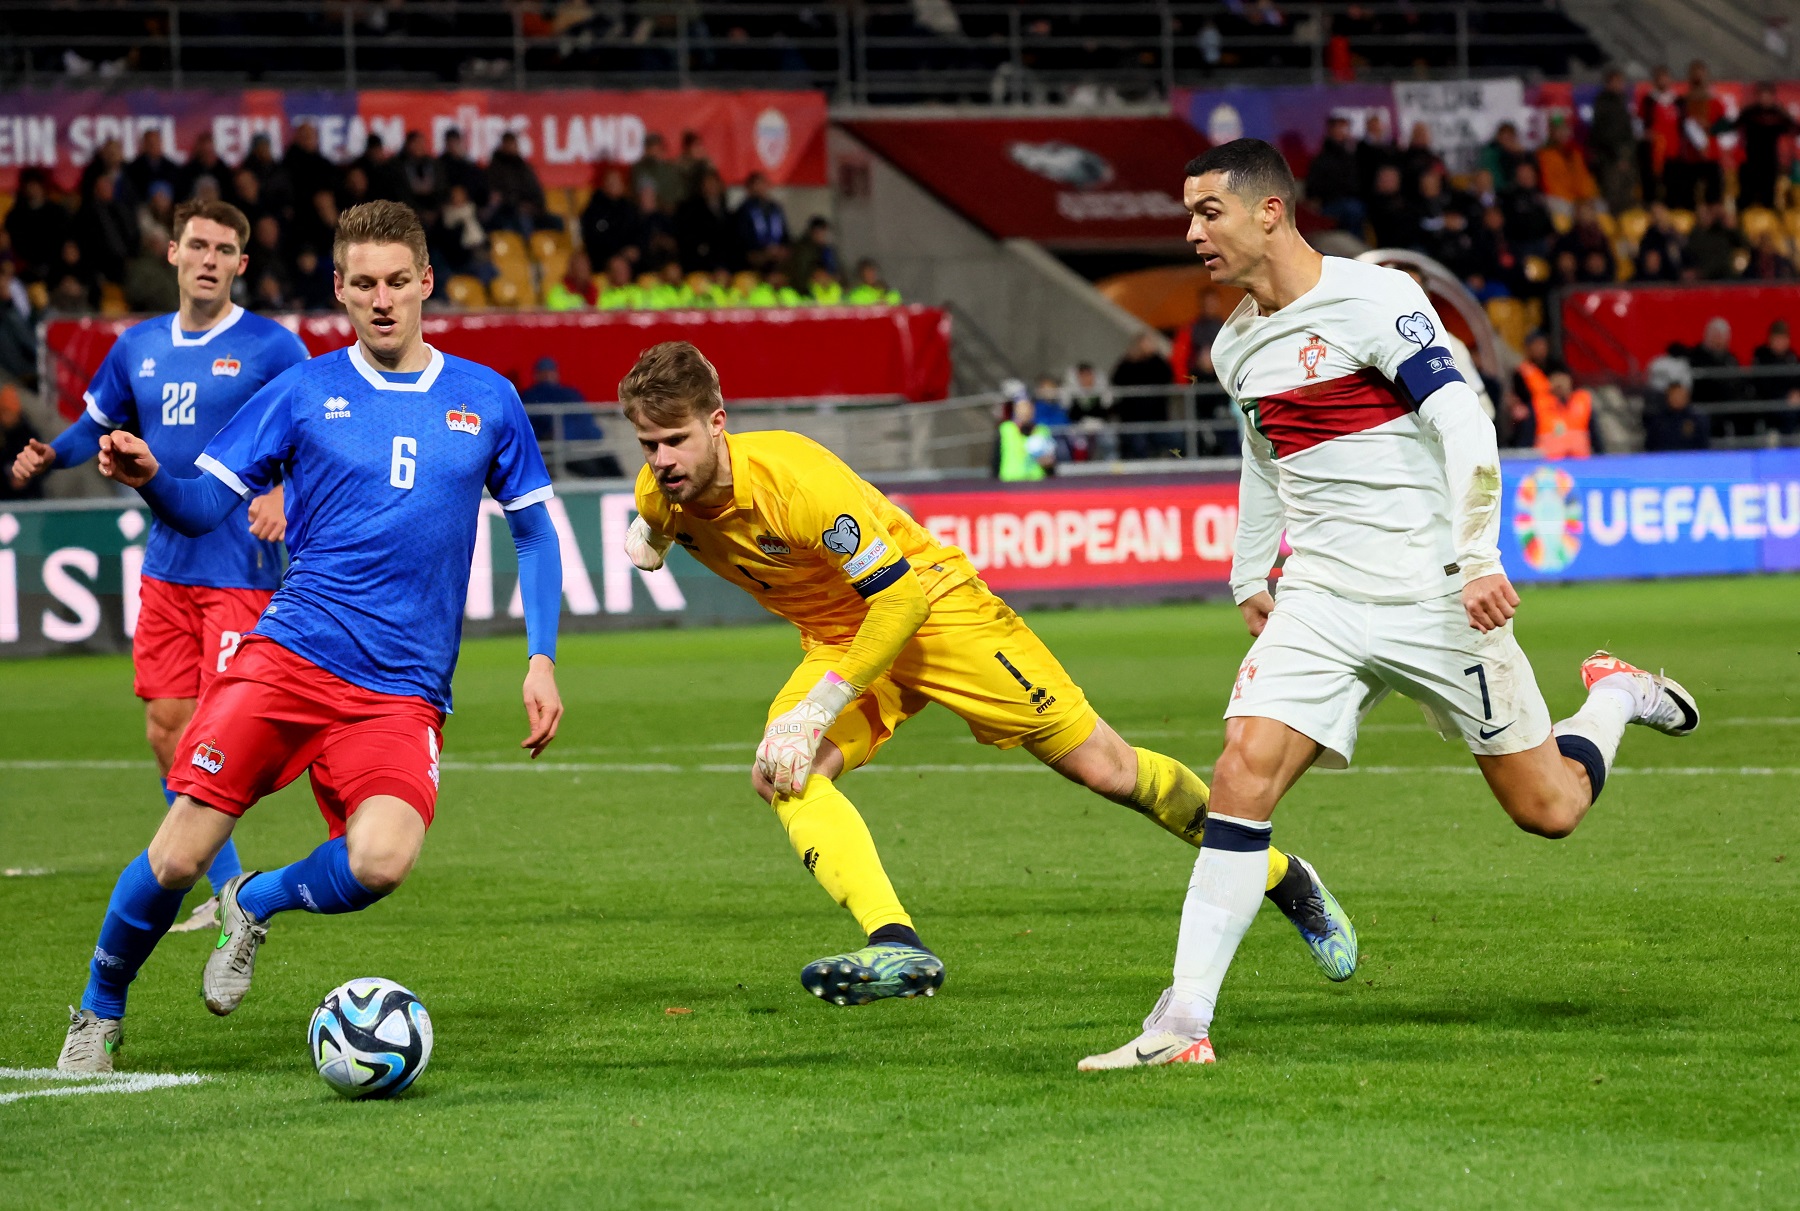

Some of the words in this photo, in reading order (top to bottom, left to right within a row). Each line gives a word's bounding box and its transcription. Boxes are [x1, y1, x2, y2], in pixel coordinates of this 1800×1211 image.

[542, 115, 645, 164] LAND
[162, 382, 197, 426] 22
[325, 410, 351, 420] errea
[389, 435, 417, 490] 6
[924, 506, 1182, 570] EUROPEAN
[217, 631, 247, 673] 2
[994, 651, 1033, 692] 1
[1036, 695, 1057, 714] errea
[1464, 663, 1492, 721] 7
